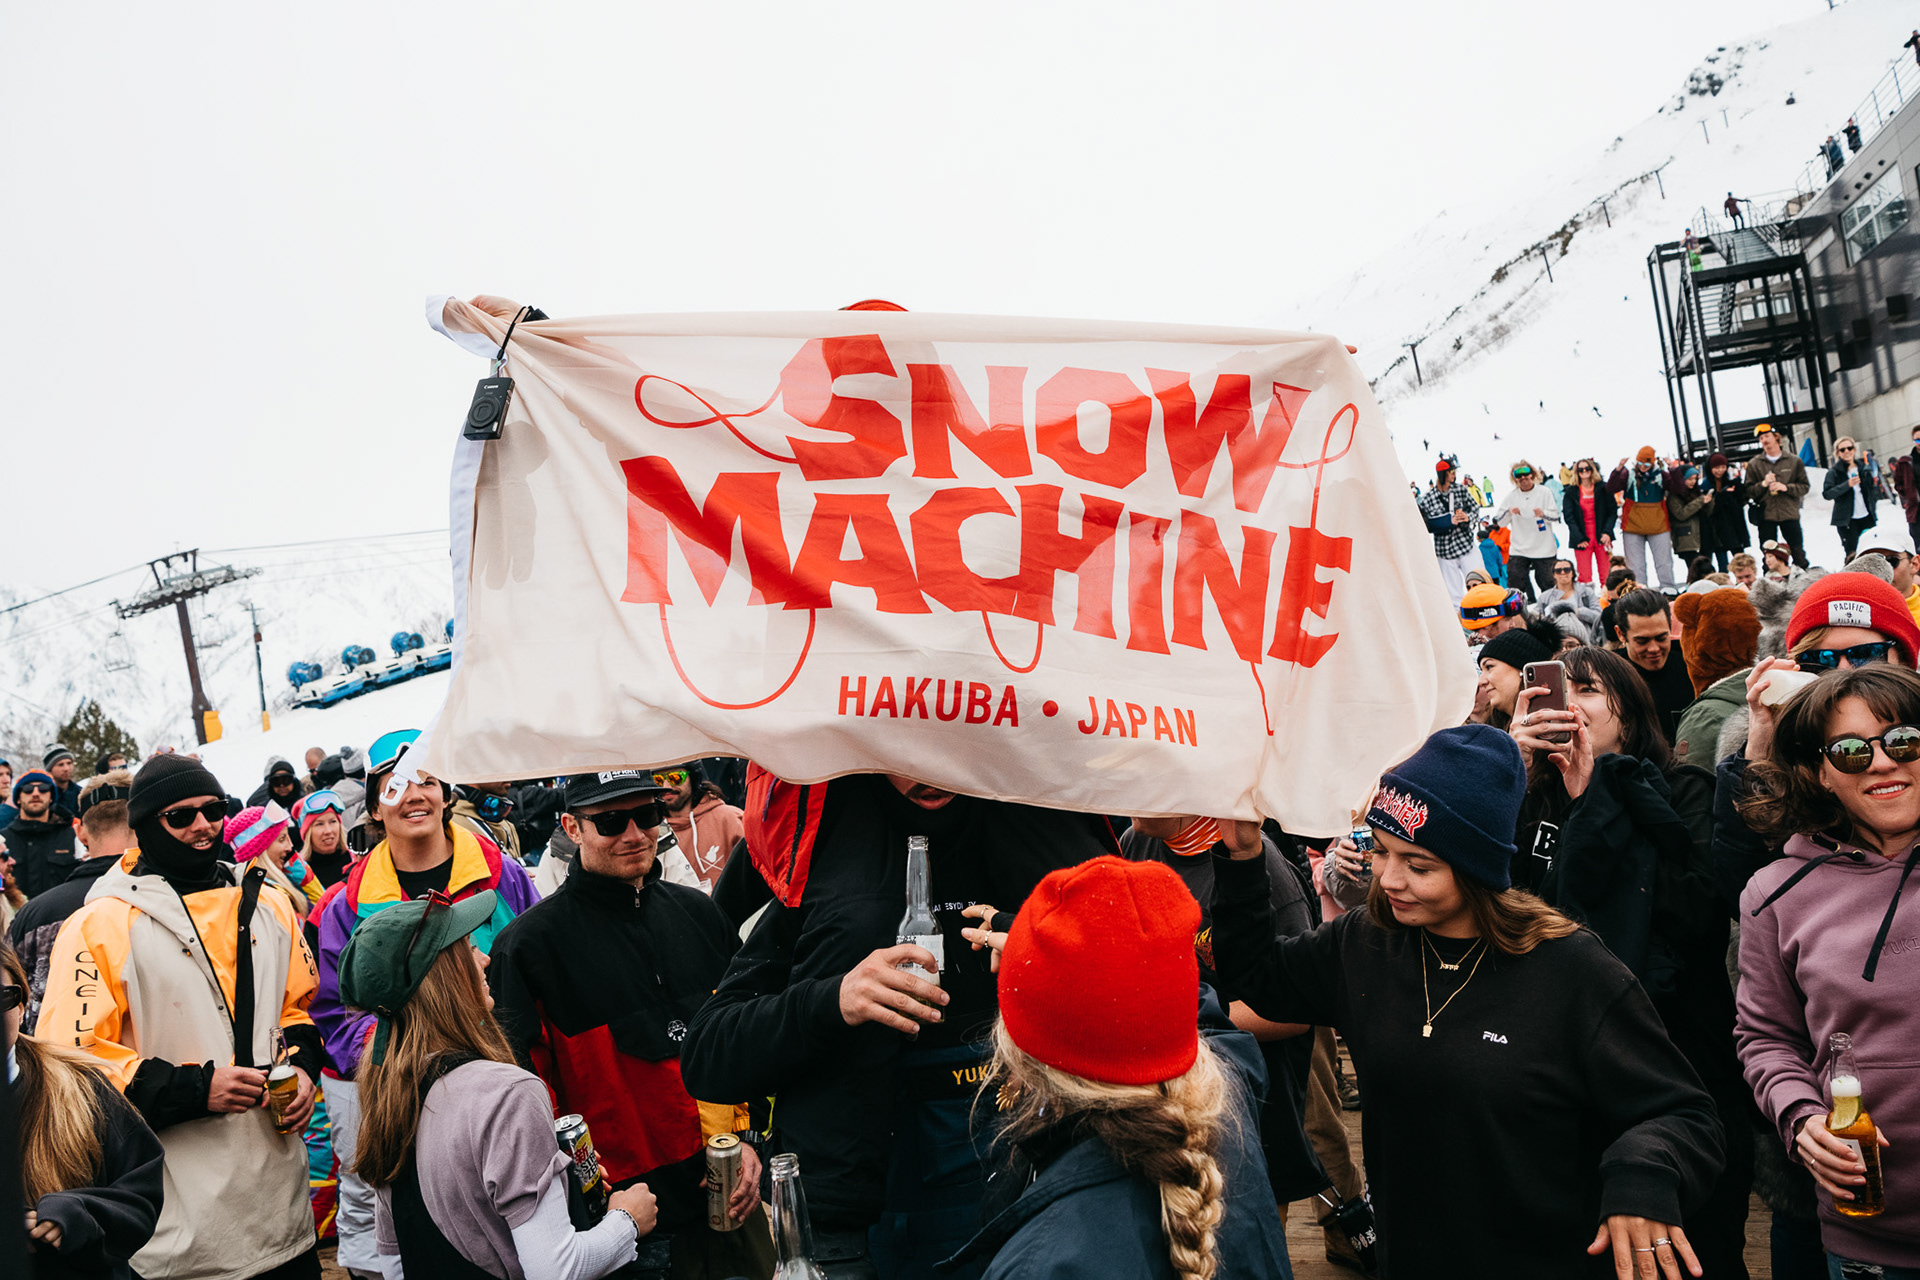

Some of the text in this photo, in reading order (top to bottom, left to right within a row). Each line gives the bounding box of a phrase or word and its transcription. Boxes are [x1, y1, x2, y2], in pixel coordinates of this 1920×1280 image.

[780, 334, 1312, 513] SNOW
[619, 456, 1353, 669] MACHINE
[1833, 602, 1865, 612] PACIFIC
[837, 675, 1198, 747] HAKUBA JAPAN
[1482, 1030, 1509, 1045] FILA
